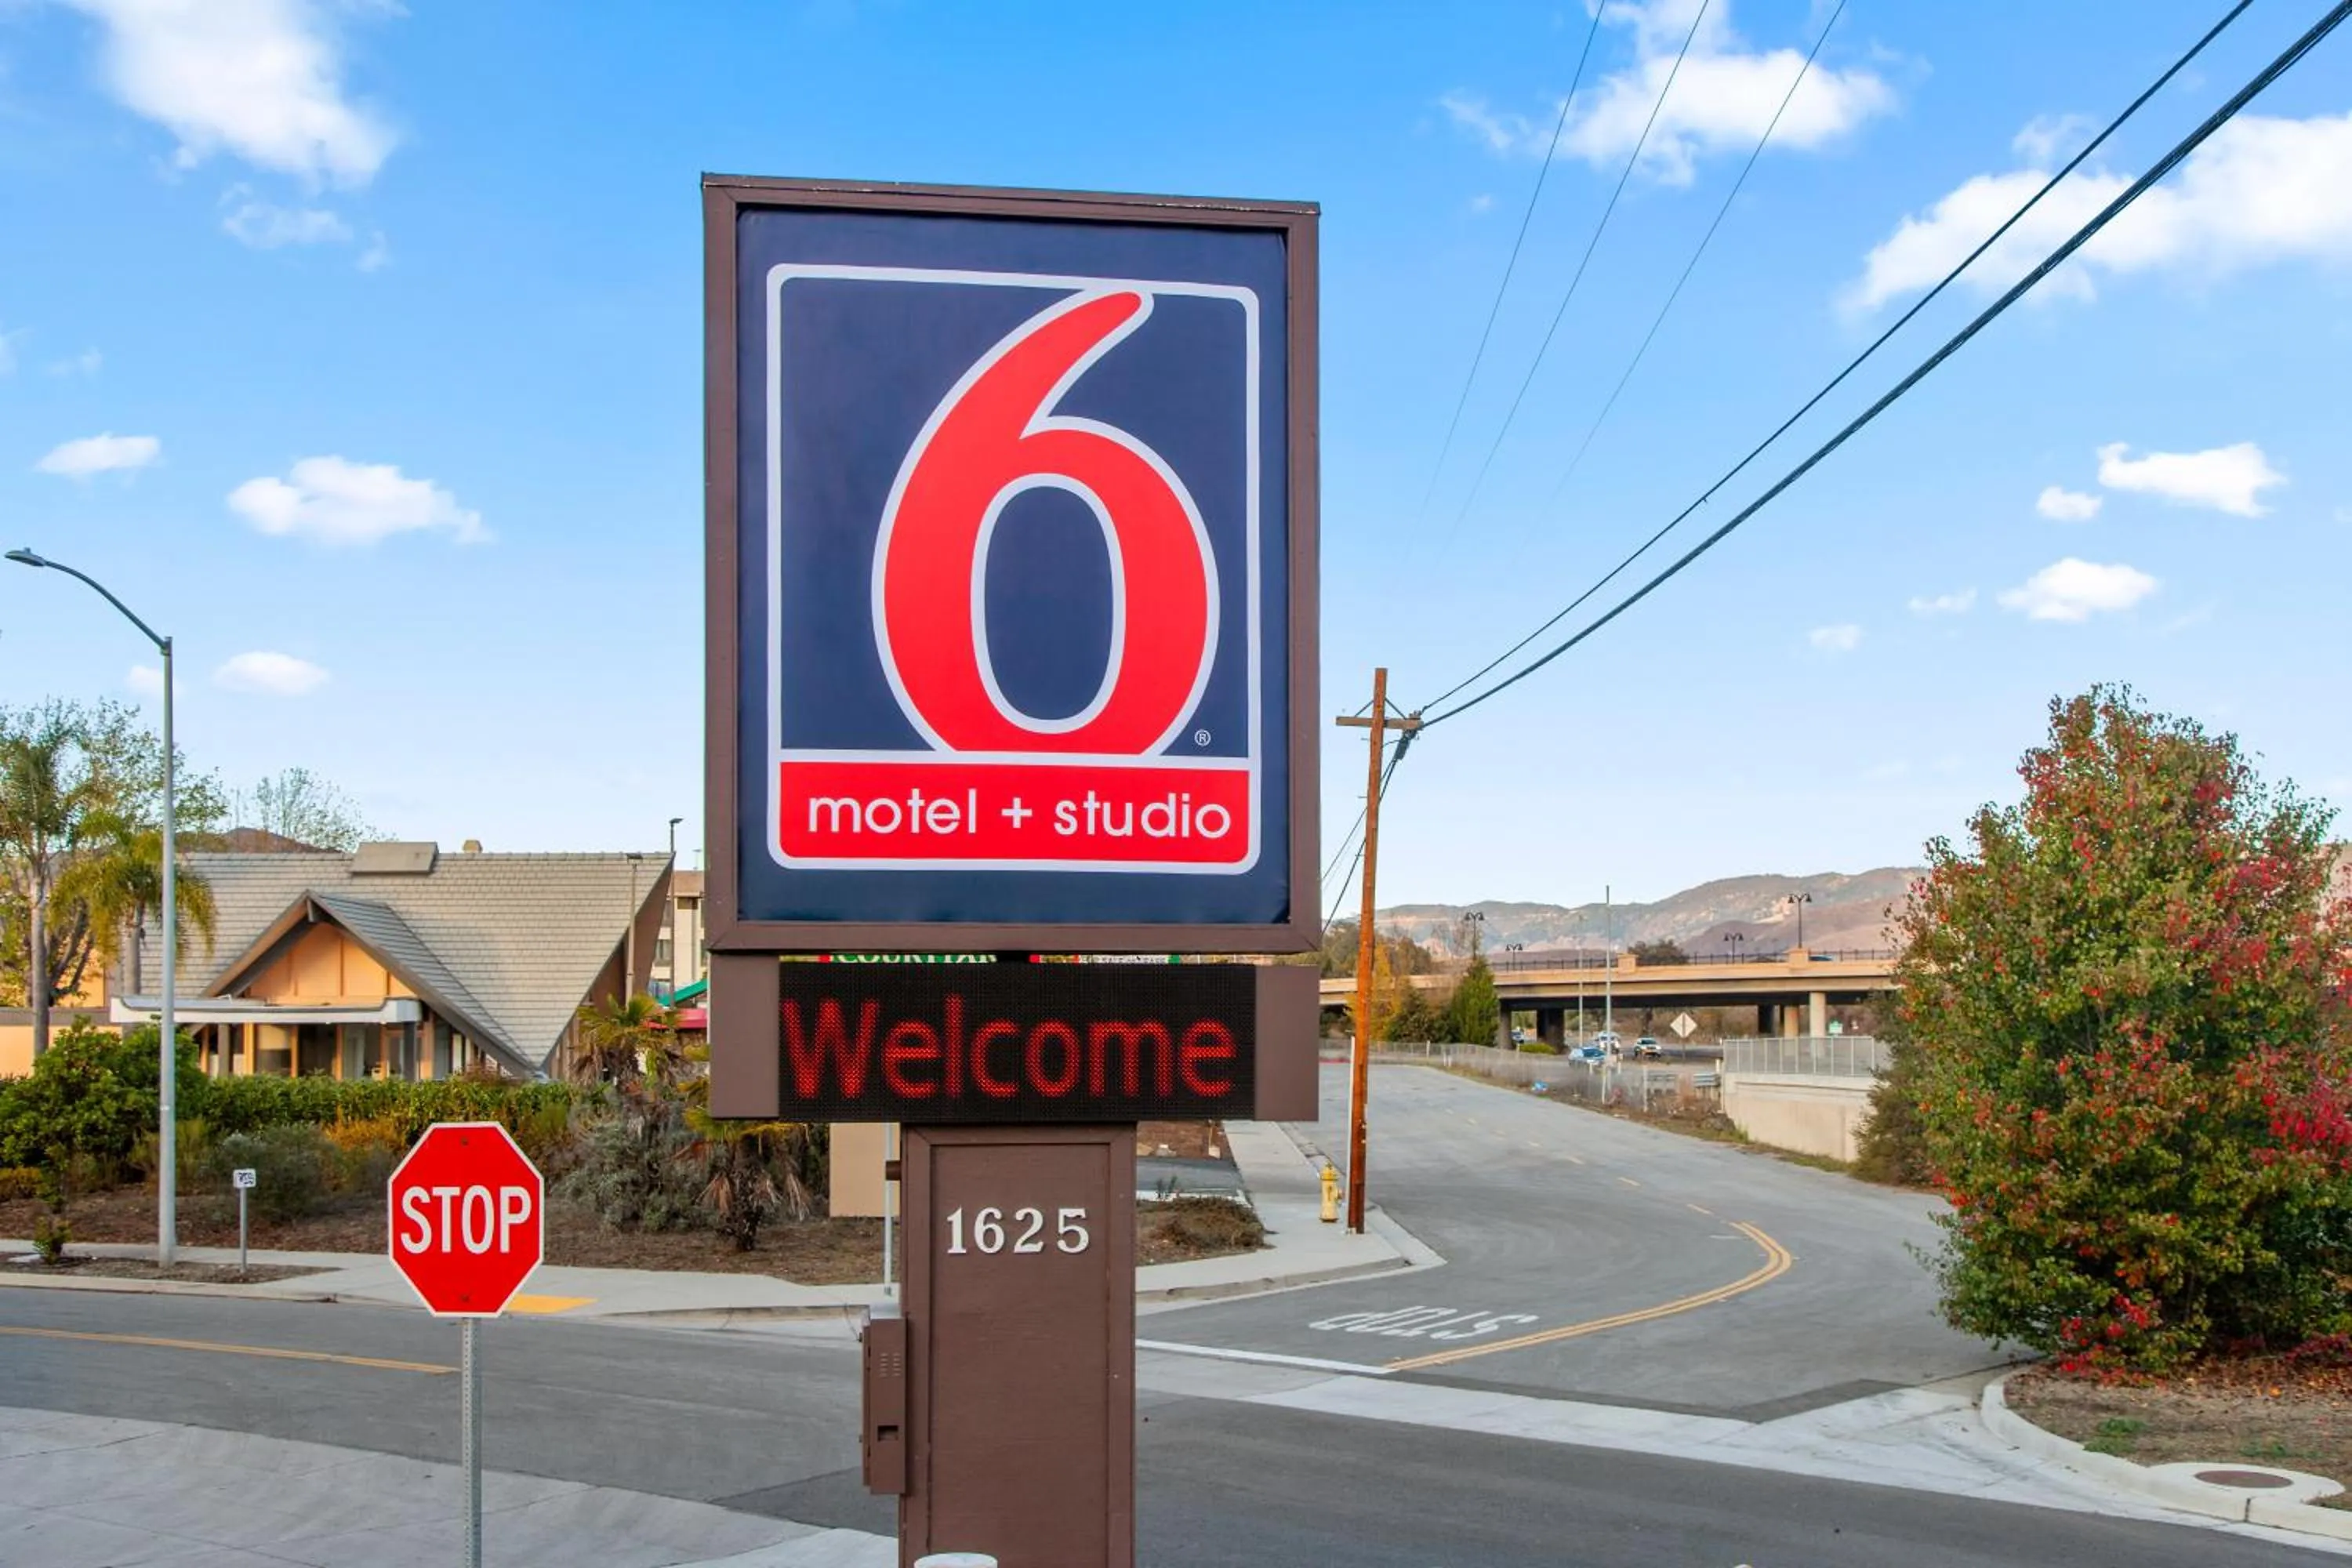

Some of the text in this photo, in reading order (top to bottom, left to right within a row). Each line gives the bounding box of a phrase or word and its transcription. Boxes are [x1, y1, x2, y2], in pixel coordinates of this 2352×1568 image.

[880, 287, 1214, 753] 6
[808, 788, 977, 834] motel
[1053, 791, 1232, 839] studio
[782, 994, 1236, 1098] Welcome
[401, 1185, 532, 1254] STOP
[946, 1206, 1090, 1254] 1625
[1308, 1305, 1540, 1340] STOP
